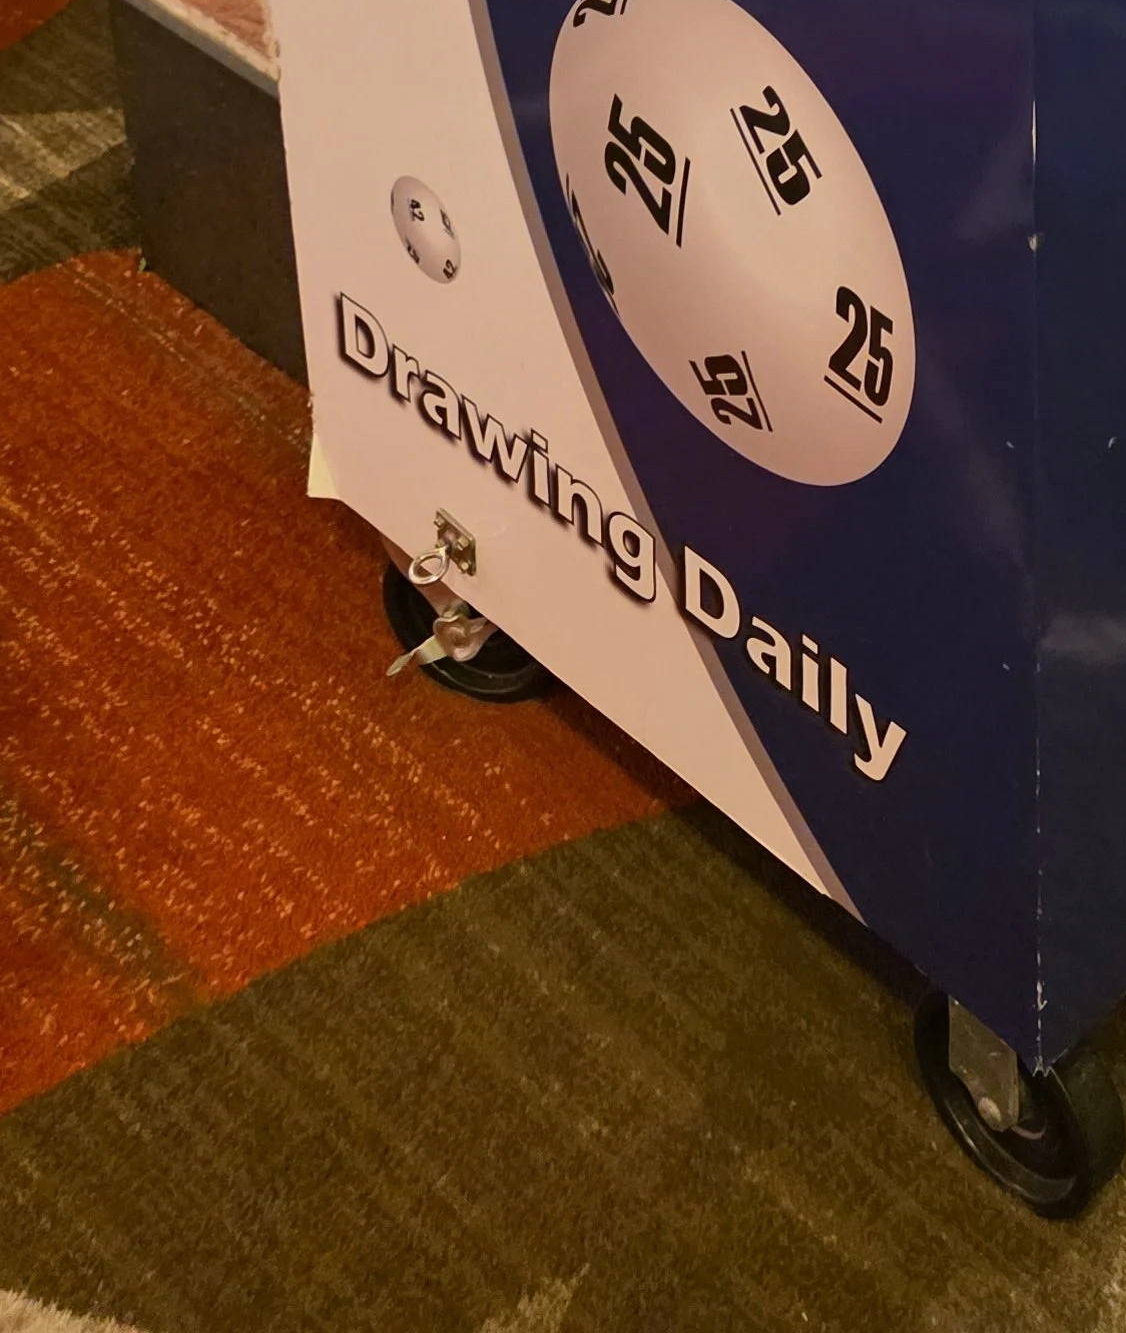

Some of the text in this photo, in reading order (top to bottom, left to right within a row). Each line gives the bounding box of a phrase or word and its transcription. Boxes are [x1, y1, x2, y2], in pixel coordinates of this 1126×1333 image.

[604, 93, 676, 235] 25
[739, 86, 822, 206] 25
[690, 354, 763, 431] 25
[828, 286, 893, 407] 25
[337, 292, 907, 782] Drawing Daily
